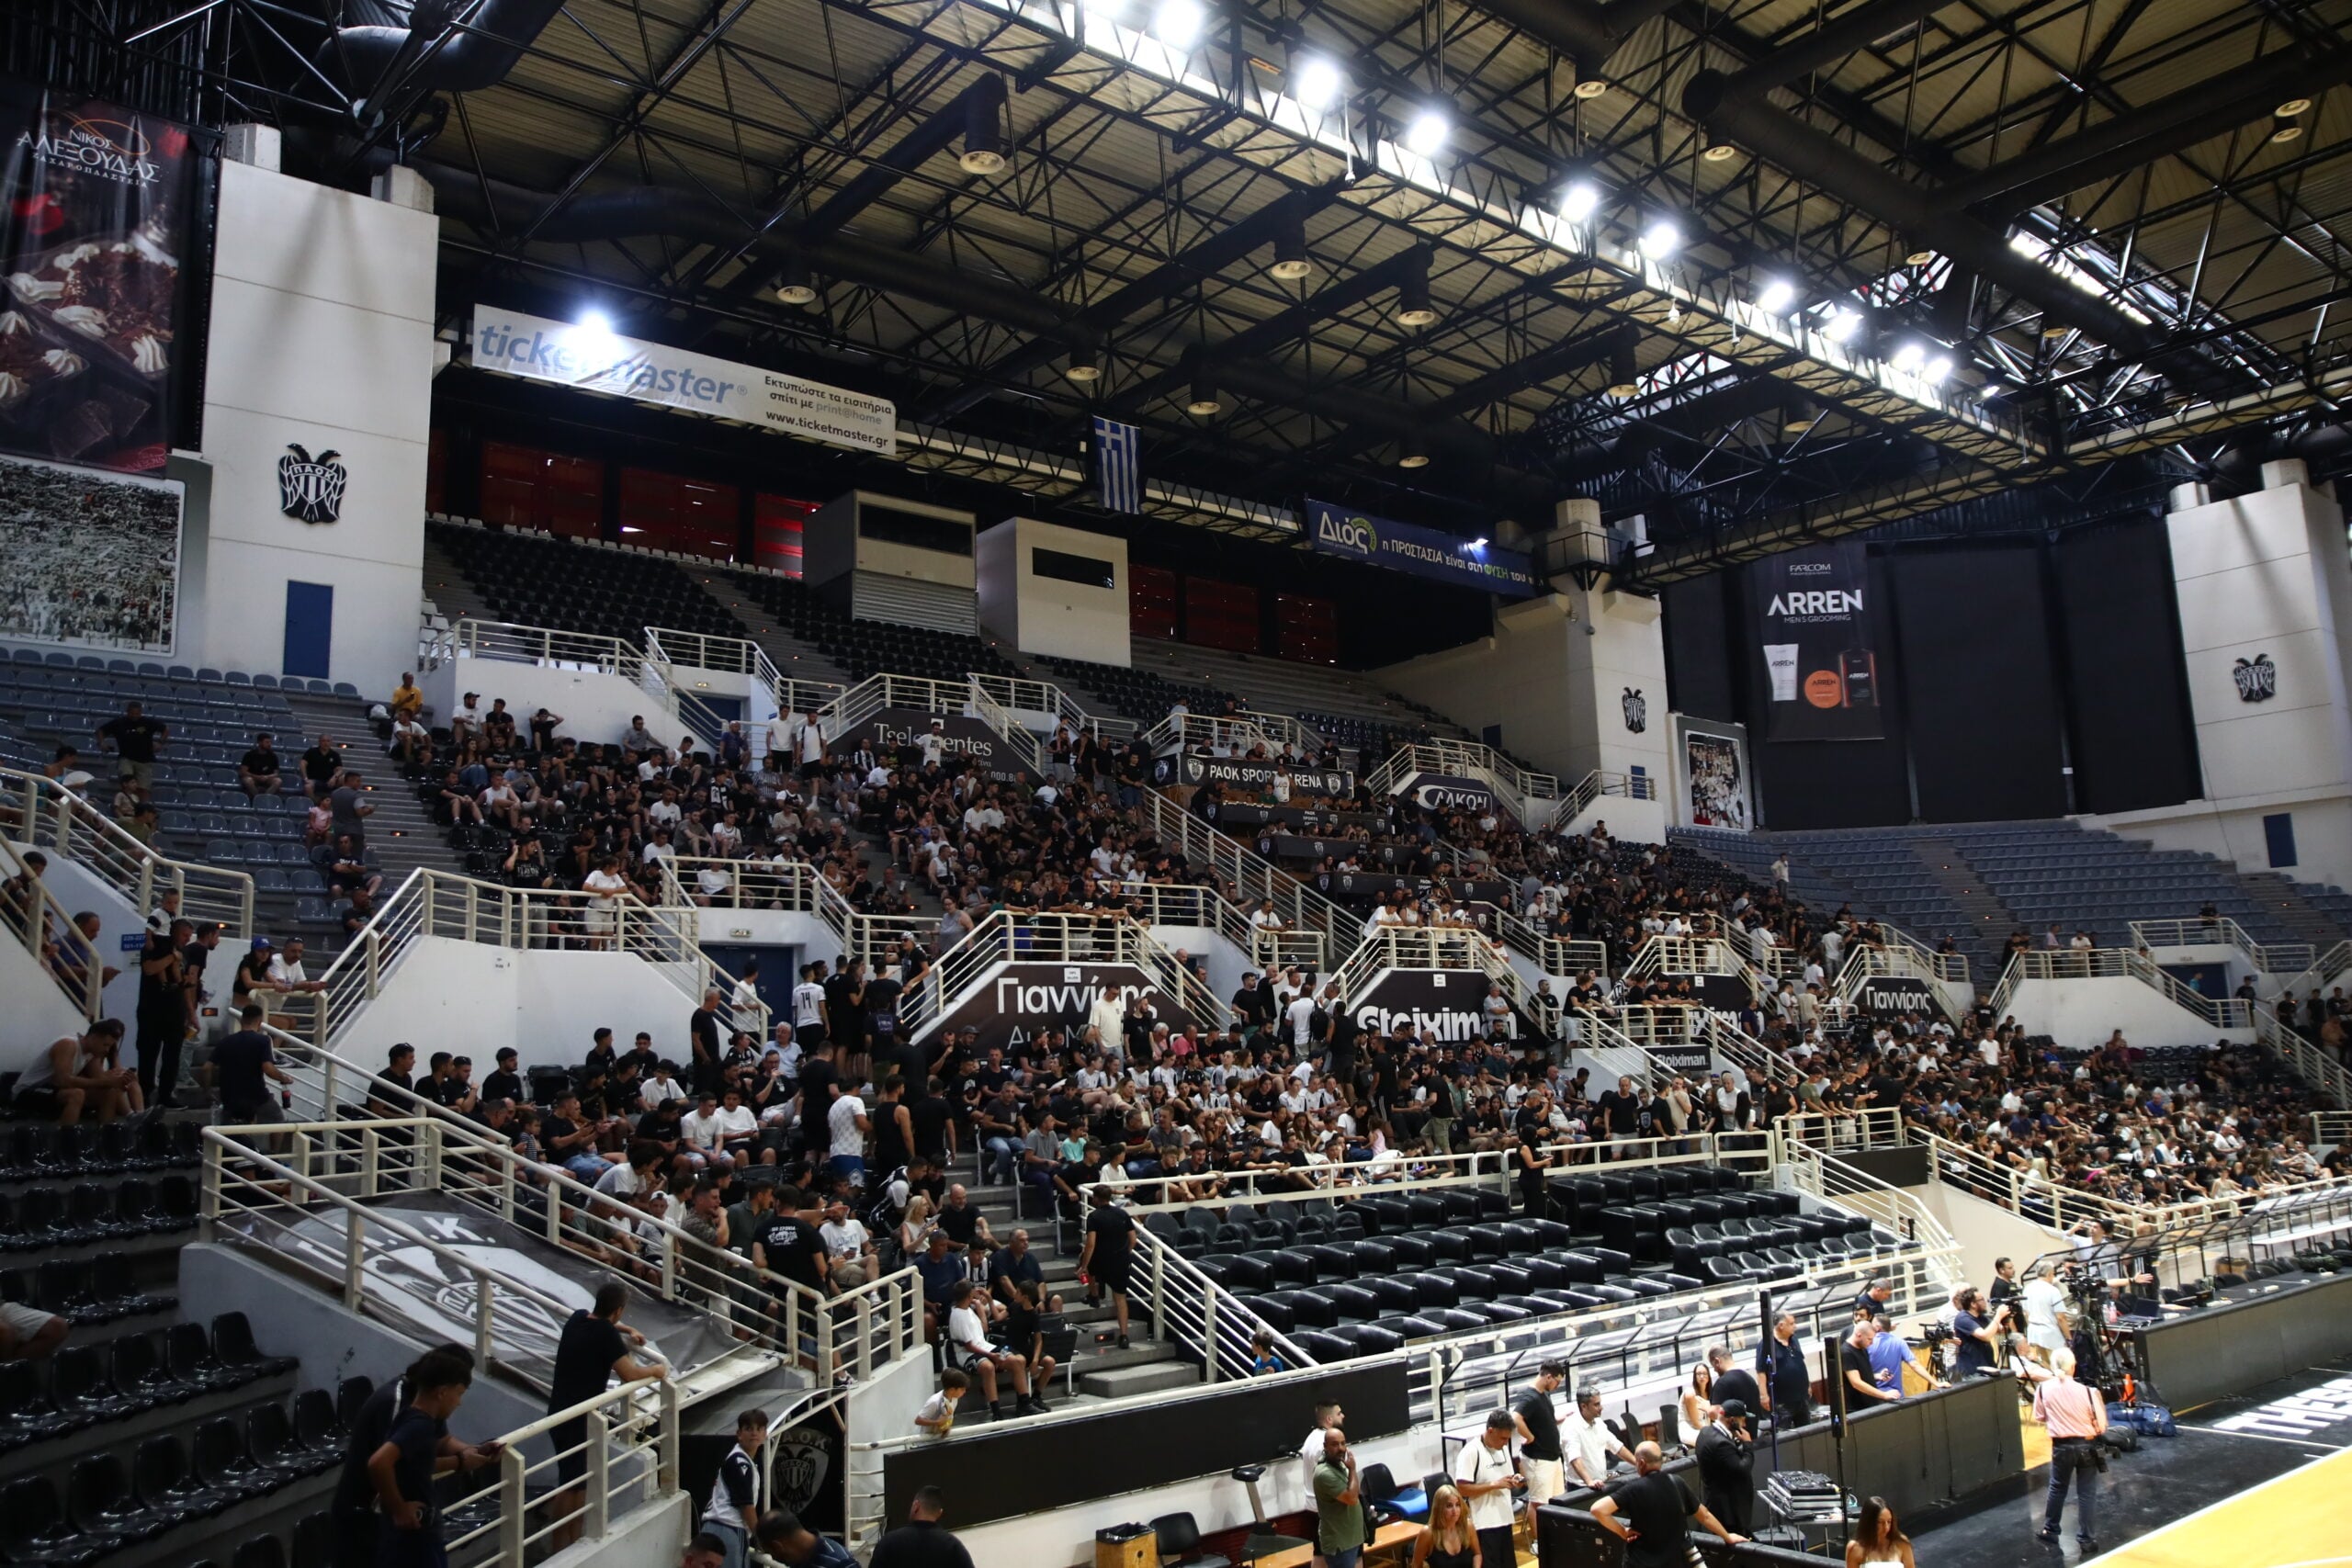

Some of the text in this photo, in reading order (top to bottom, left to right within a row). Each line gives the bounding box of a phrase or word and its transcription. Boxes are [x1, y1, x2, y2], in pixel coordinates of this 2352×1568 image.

[69, 129, 113, 150] ΝΙΚΟΣ
[764, 376, 892, 414] Εκτυπώστε τα εισιτήρια
[770, 391, 882, 425] σπίτι με print@home
[765, 412, 888, 448] www.ticketmaster.gr
[1318, 511, 1368, 555] Διός
[1391, 539, 1442, 564] ΠΡΟΣΤΑΣΙΑ
[1445, 554, 1466, 570] είναι
[1767, 589, 1863, 616] ARREN
[1209, 764, 1240, 781] PAOK
[800, 991, 812, 1010] 14
